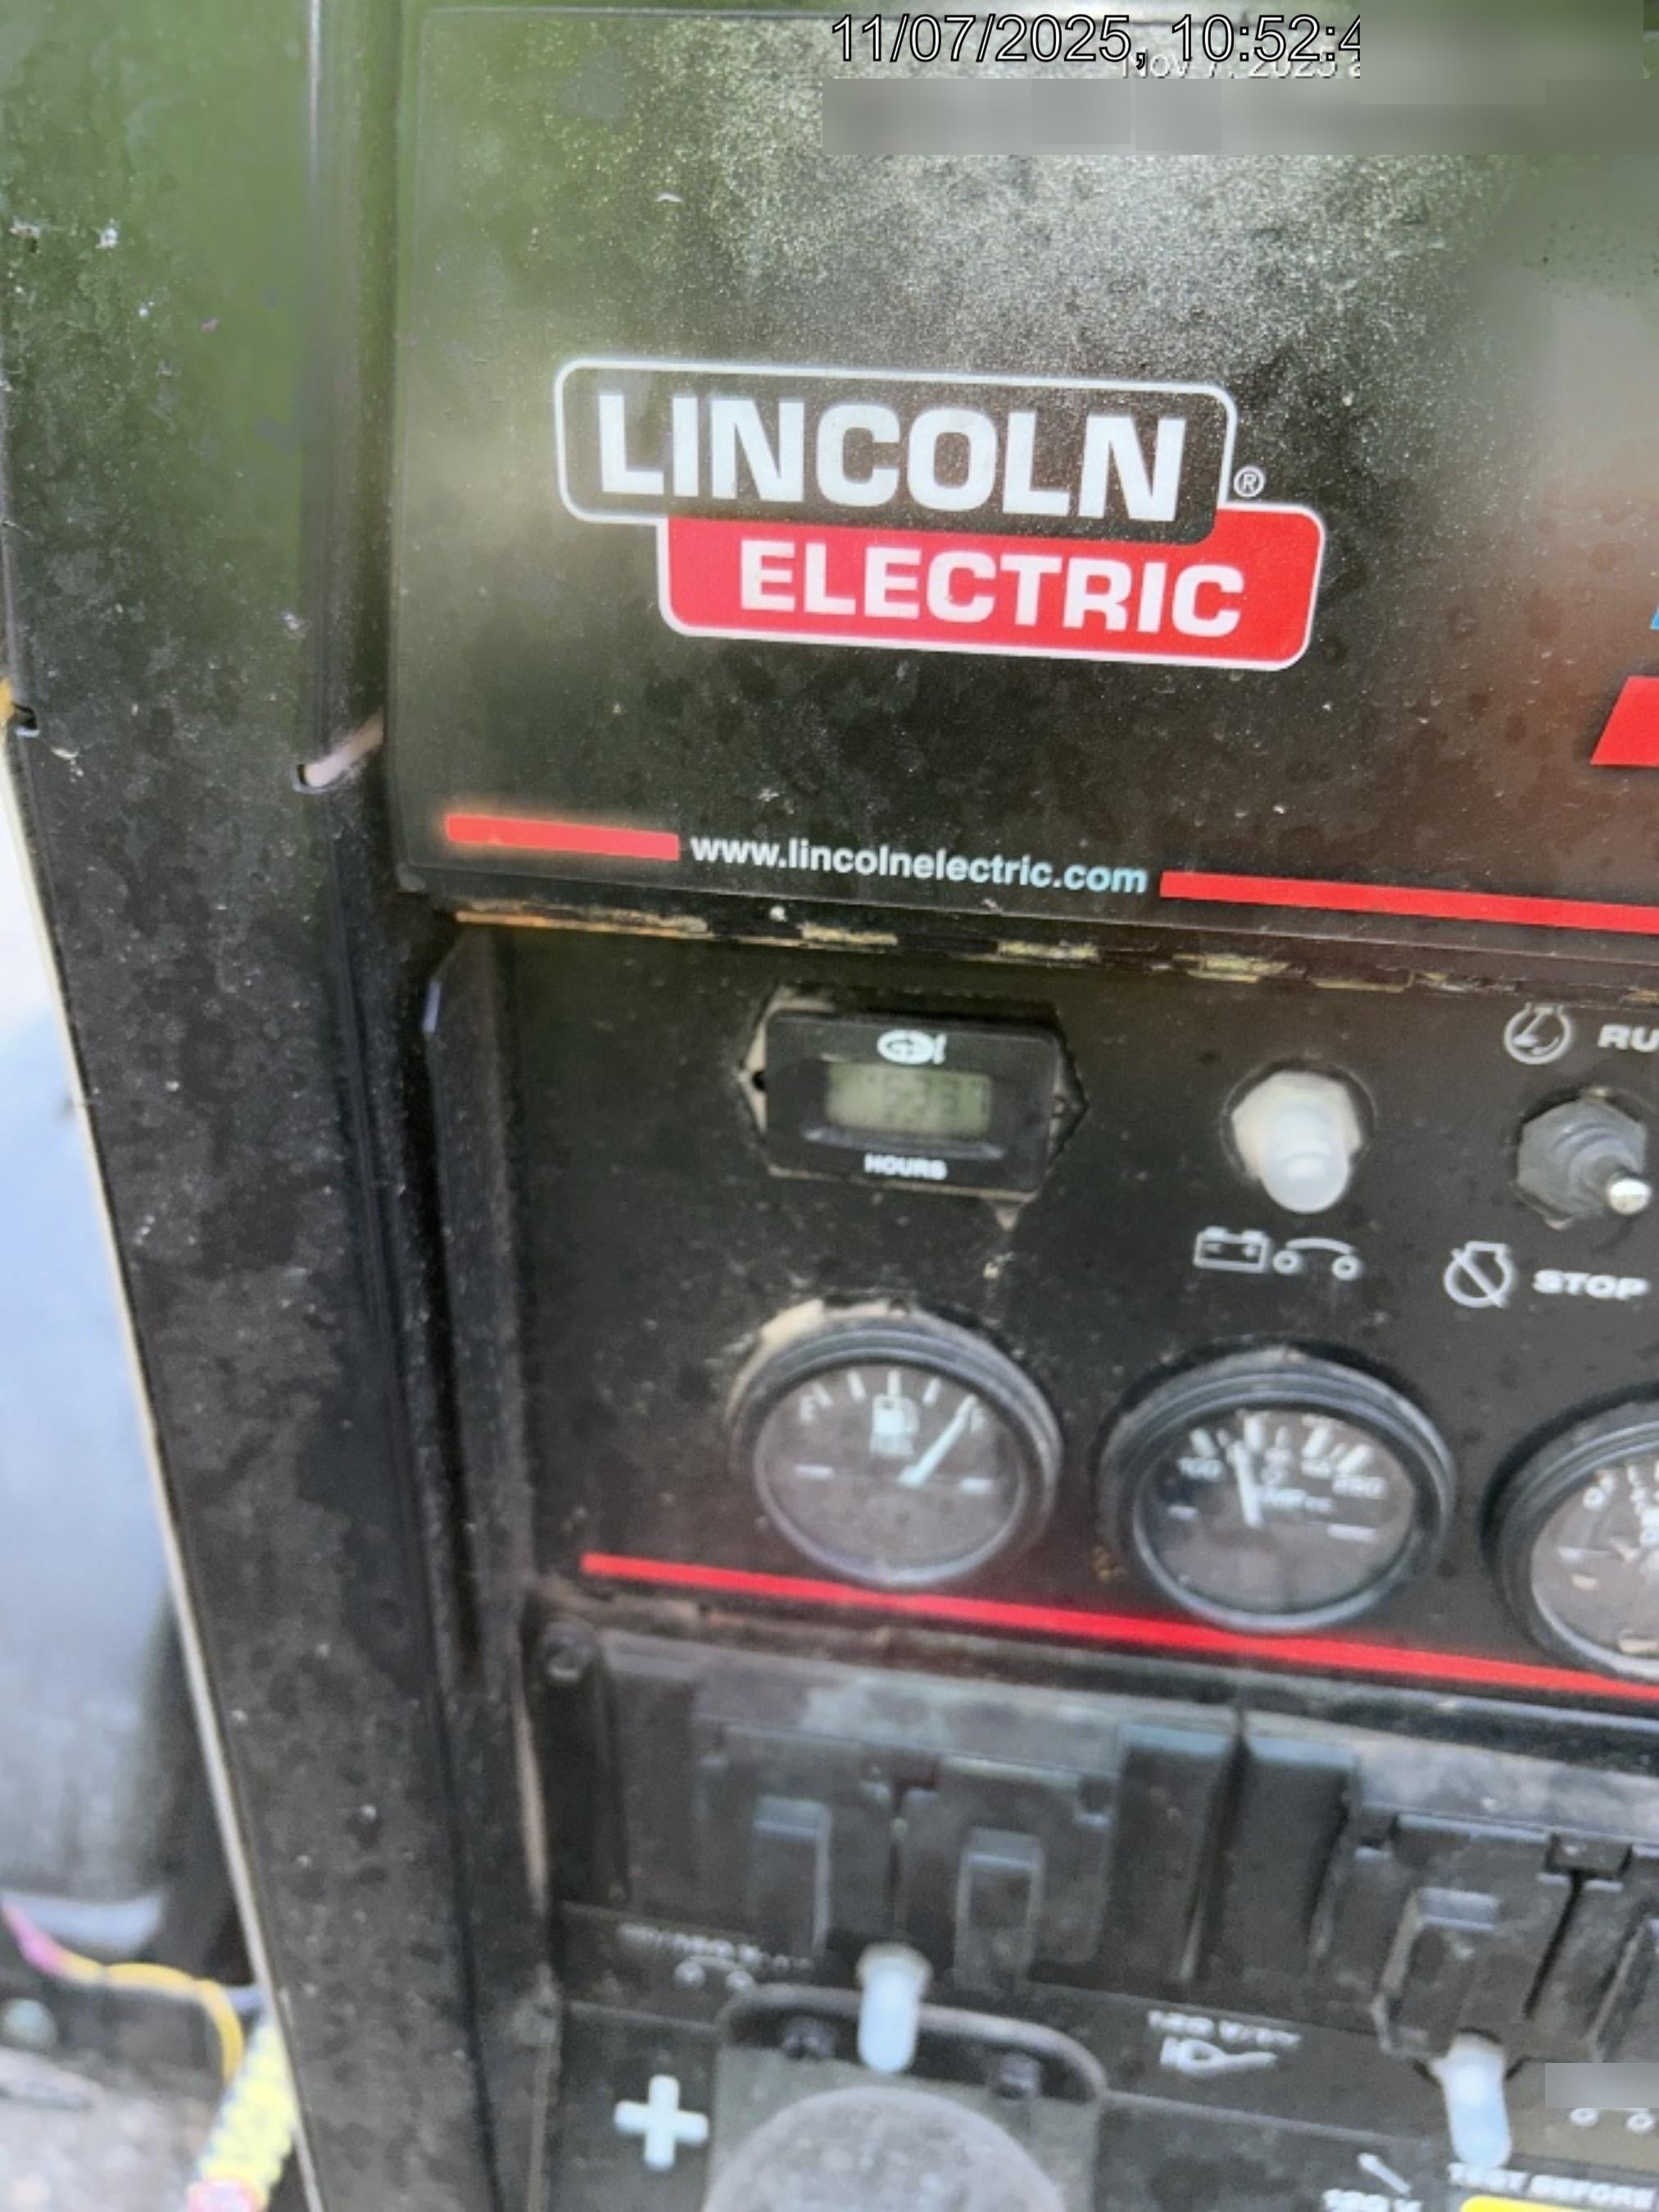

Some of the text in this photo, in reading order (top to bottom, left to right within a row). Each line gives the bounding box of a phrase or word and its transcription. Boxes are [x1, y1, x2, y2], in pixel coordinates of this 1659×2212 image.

[598, 393, 1187, 523] LINCOLN
[738, 538, 1245, 639] ELECTRIC
[689, 836, 1149, 894] www.lincolnelectric.com
[1597, 1024, 1659, 1053] RU
[863, 1152, 948, 1181] HOURS
[1532, 1269, 1650, 1302] STOP
